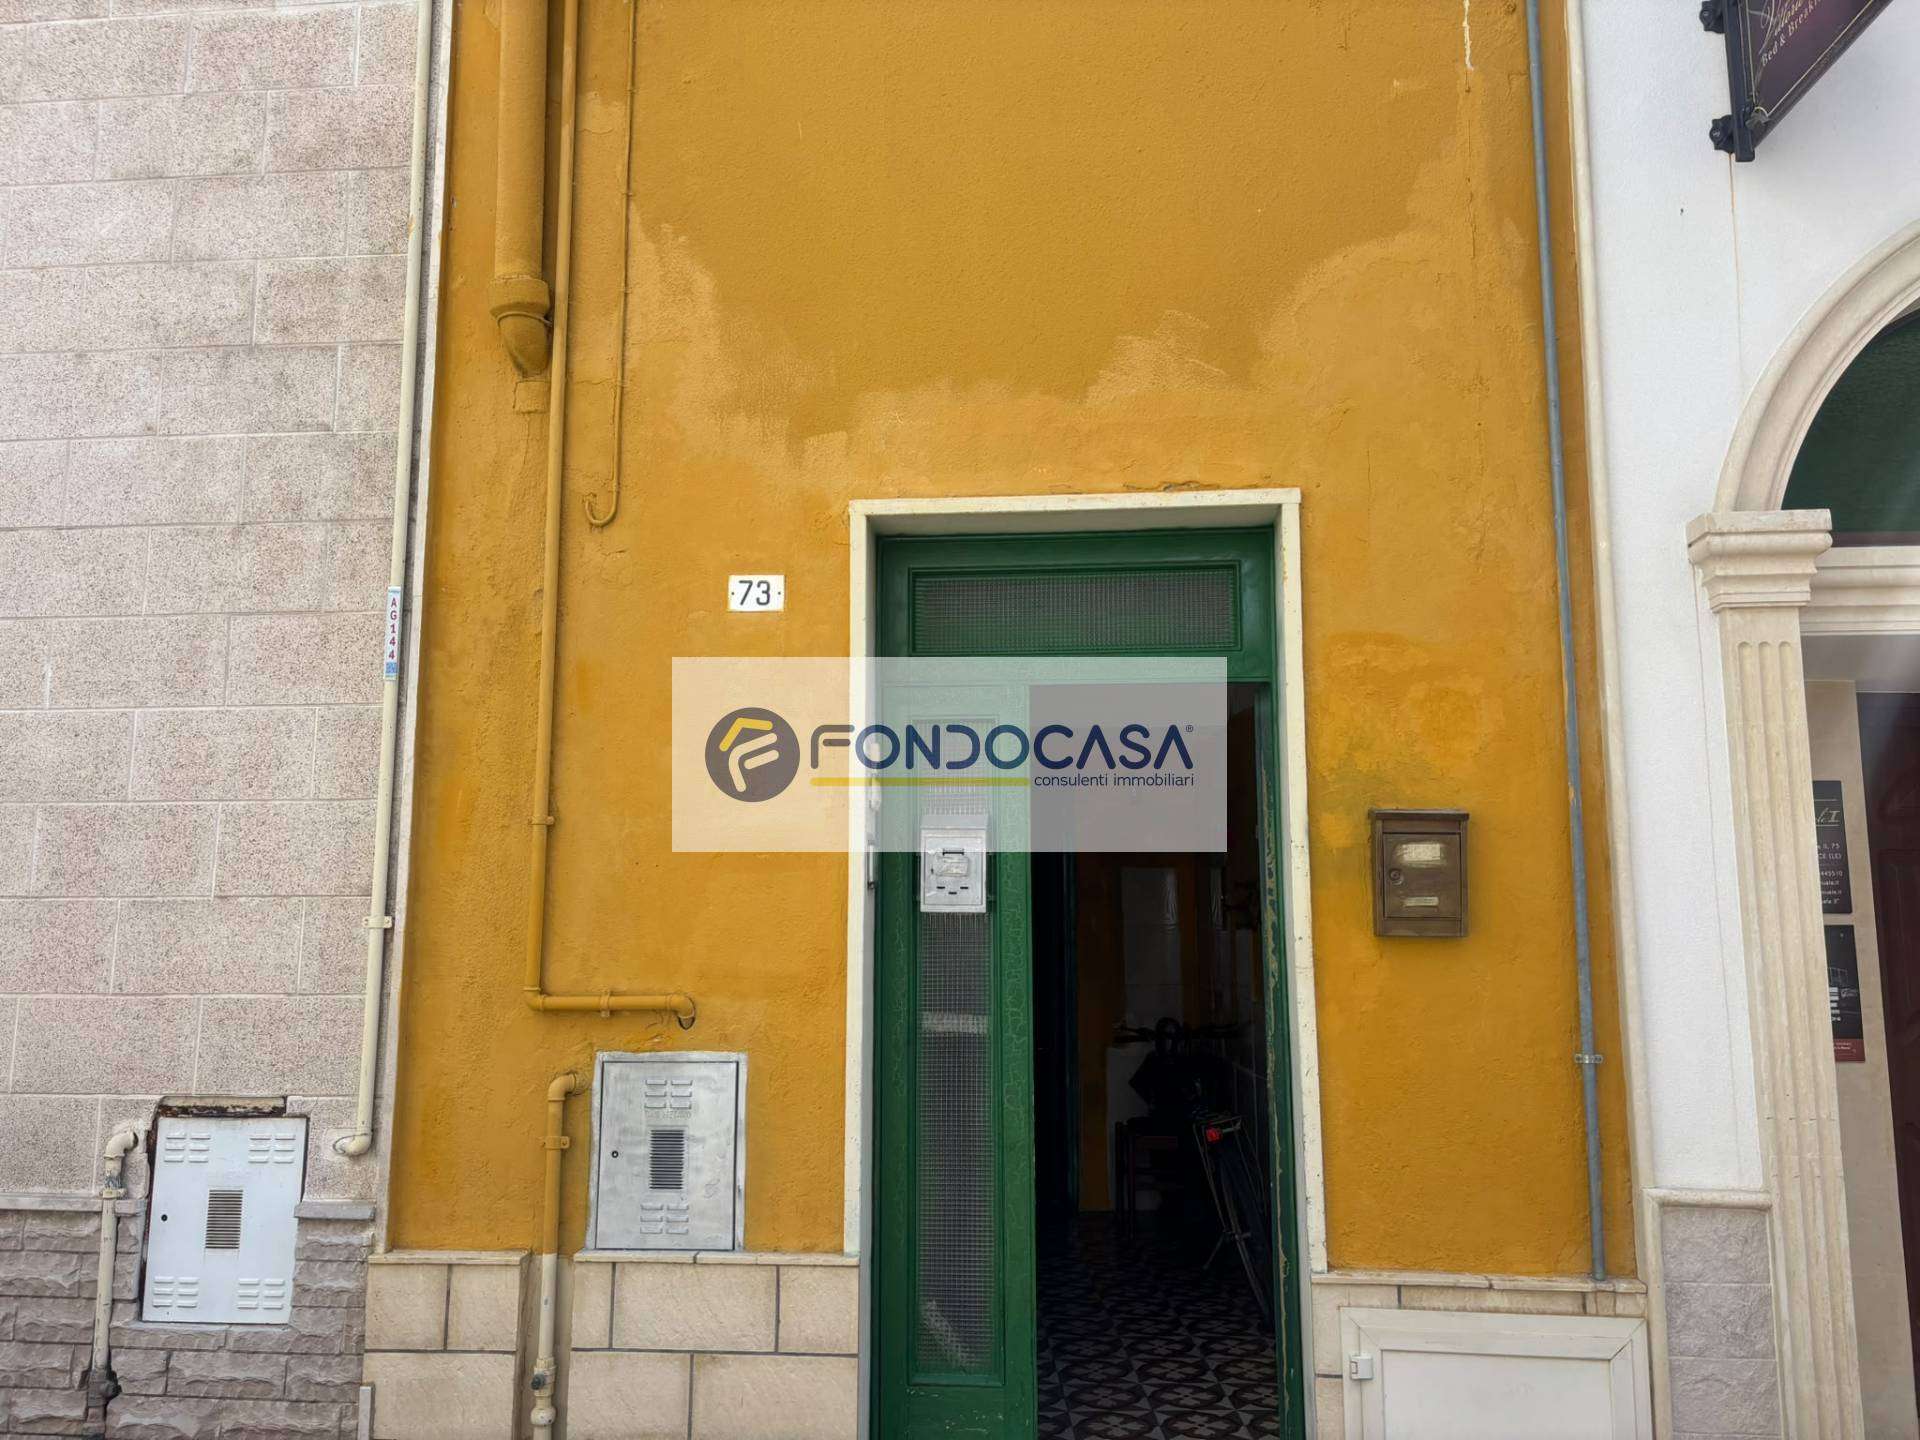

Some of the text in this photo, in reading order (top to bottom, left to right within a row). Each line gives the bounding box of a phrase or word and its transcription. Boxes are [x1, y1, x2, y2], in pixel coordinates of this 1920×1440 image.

[1761, 41, 1778, 66] Bed
[1779, 33, 1786, 46] &
[739, 580, 771, 606] 73
[388, 597, 398, 660] AG144
